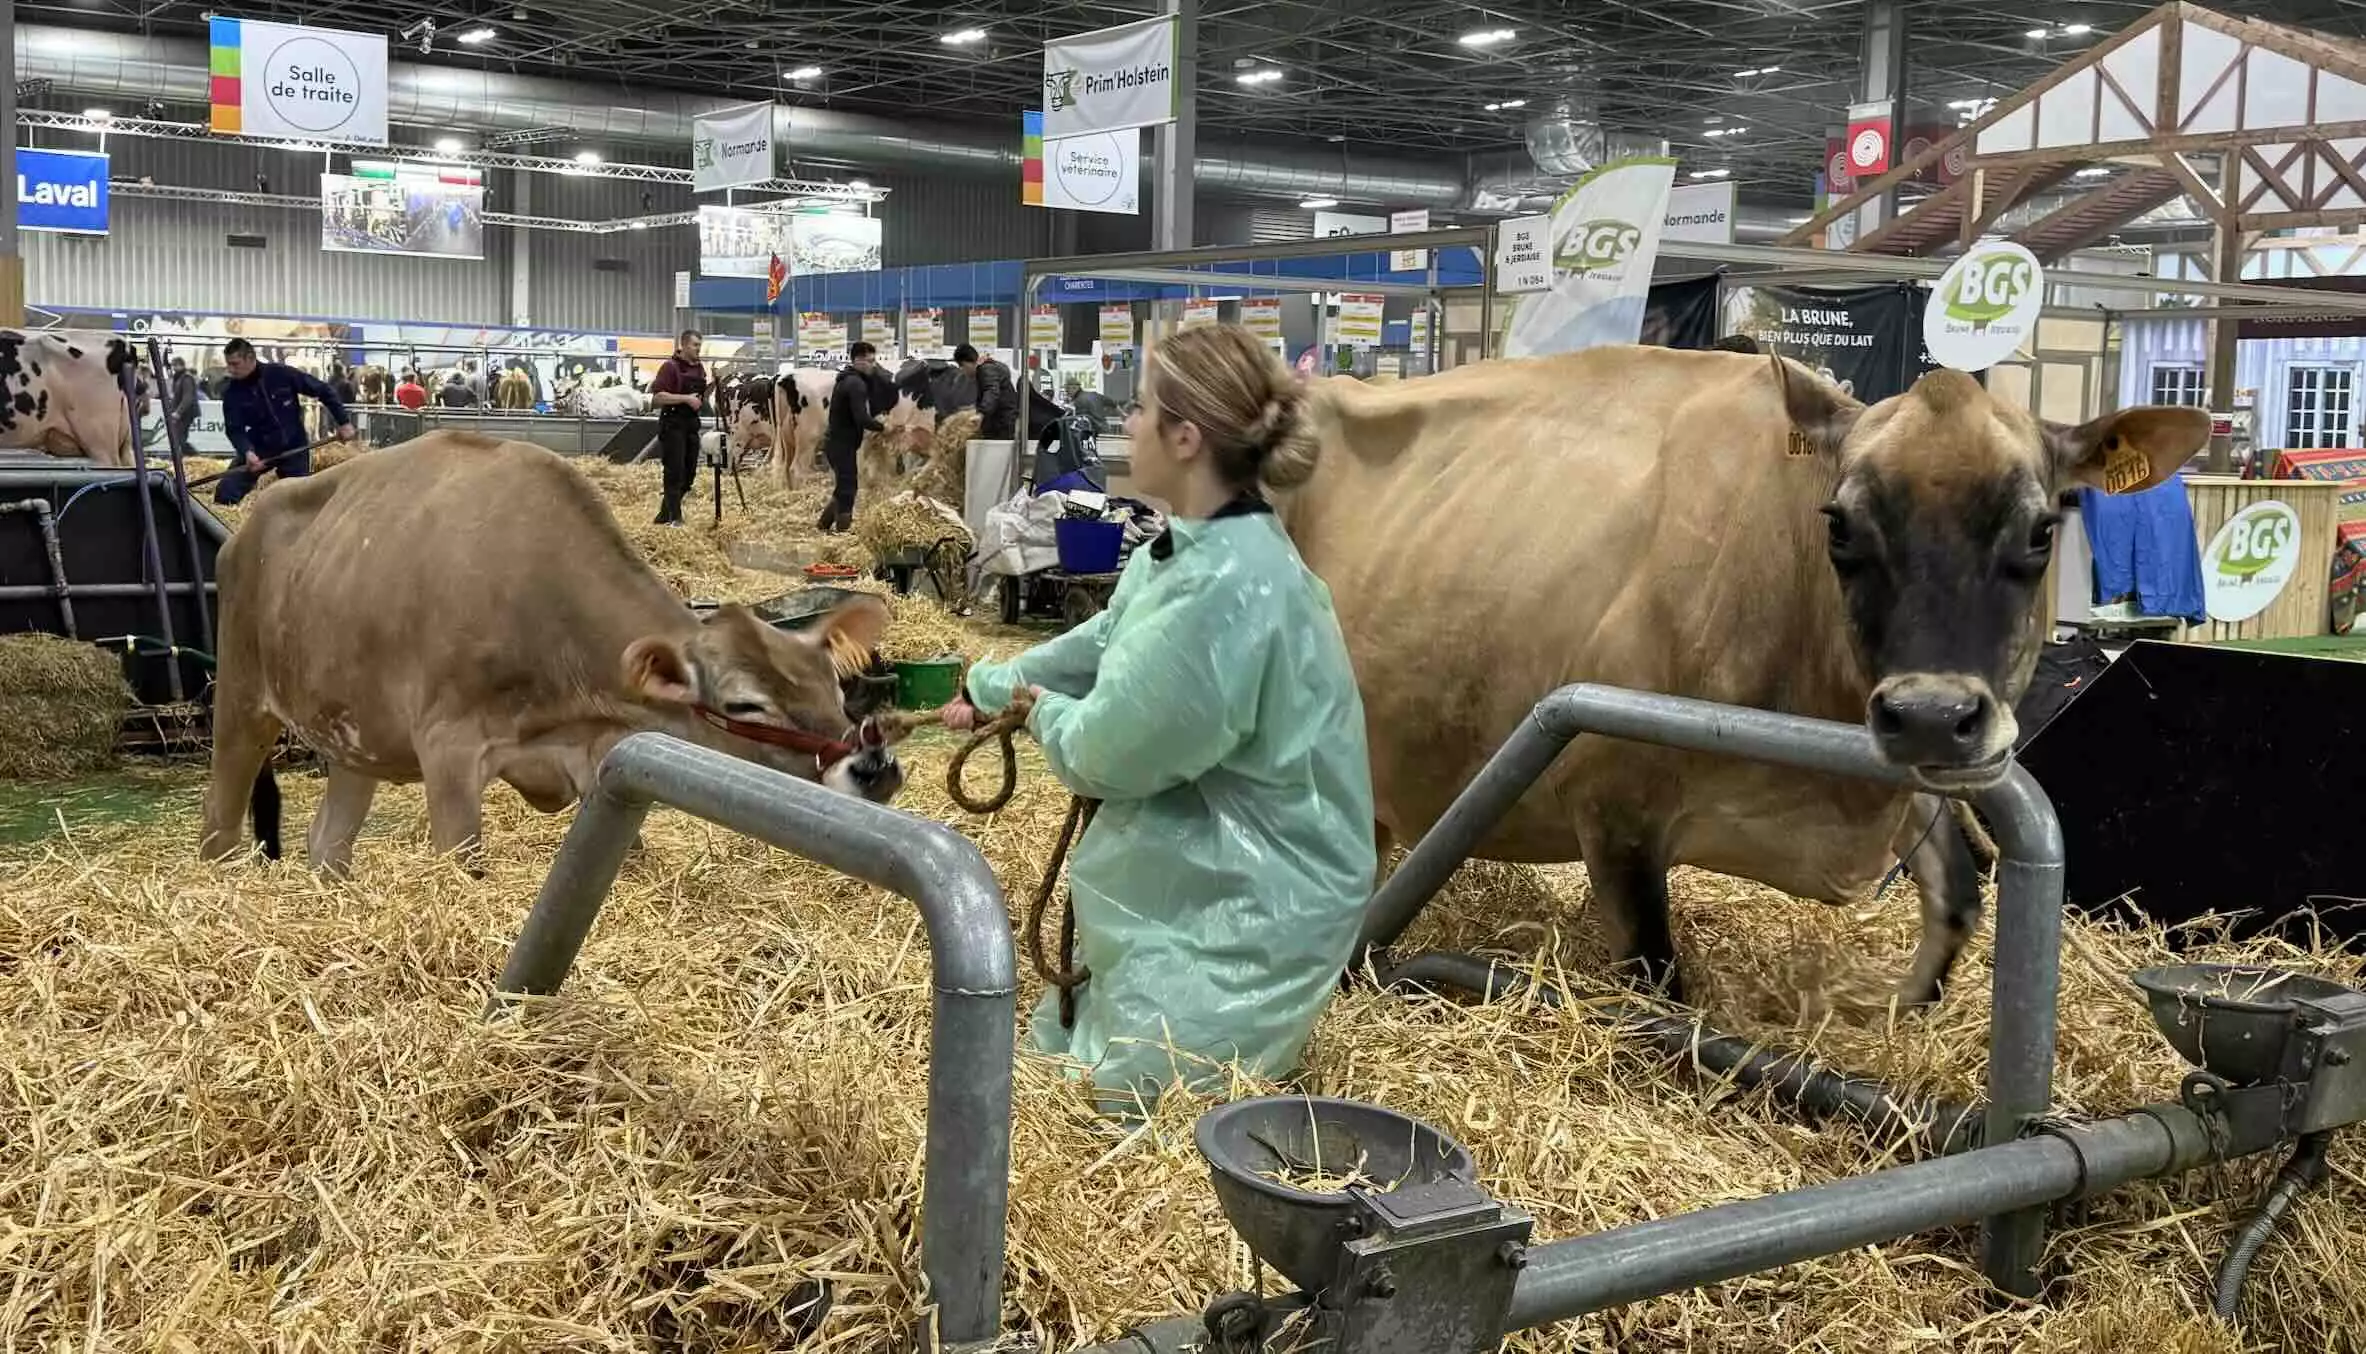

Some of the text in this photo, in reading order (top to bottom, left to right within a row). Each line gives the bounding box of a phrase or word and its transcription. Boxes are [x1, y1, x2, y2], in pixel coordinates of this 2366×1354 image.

[289, 64, 335, 84] Salle
[1086, 63, 1169, 95] Prim'Holstein
[271, 80, 353, 103] de traite
[721, 139, 767, 159] Normande
[1070, 151, 1109, 167] Service
[1561, 225, 1640, 261] BGS
[1959, 260, 2030, 305] BGS
[1781, 307, 1853, 328] LA BRUNE,
[1758, 330, 1873, 347] BIEN PLUS QUE DU LAIT
[2229, 518, 2290, 560] BGS
